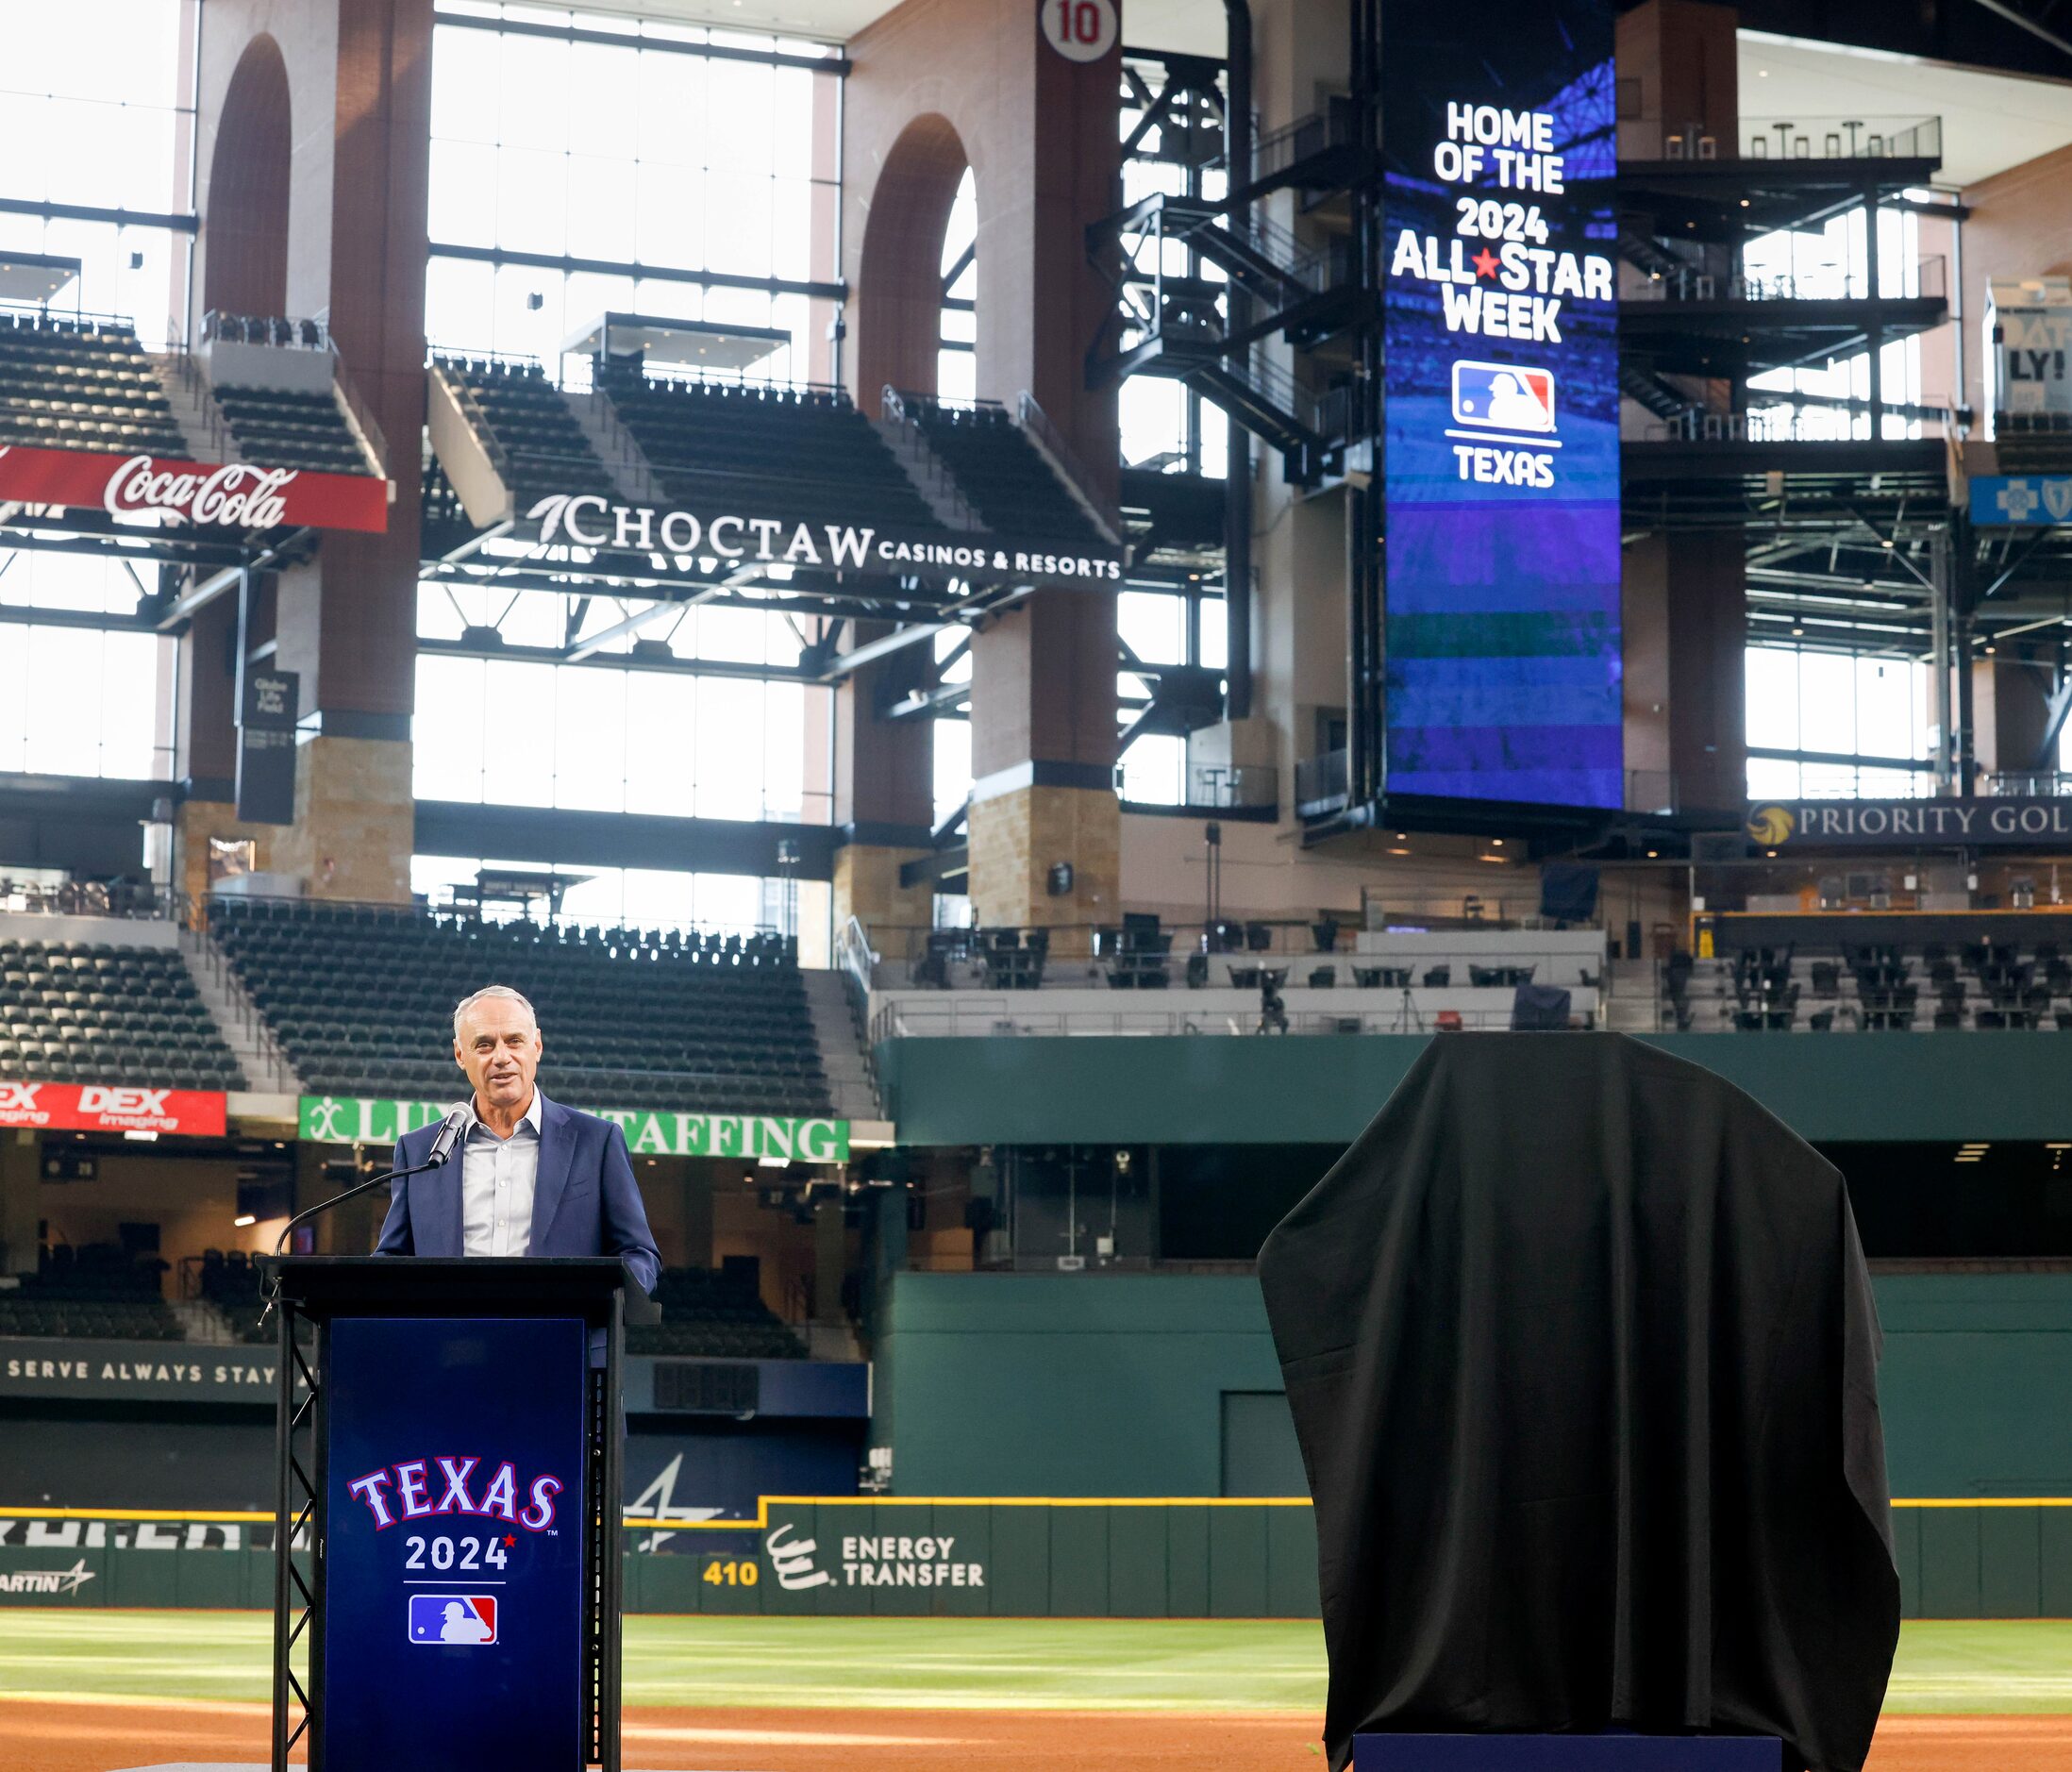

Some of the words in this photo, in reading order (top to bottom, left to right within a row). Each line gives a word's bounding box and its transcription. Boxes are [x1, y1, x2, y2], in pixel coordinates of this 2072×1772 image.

[1058, 0, 1100, 43] 10
[1447, 101, 1554, 153] HOME
[1434, 142, 1484, 183] OF
[1492, 148, 1565, 194] THE
[1456, 197, 1549, 244] 2024
[1391, 228, 1477, 285] ALL
[1500, 242, 1613, 301] STAR
[1441, 282, 1562, 343] WEEK
[2010, 350, 2064, 380] LY!
[1452, 444, 1555, 488] TEXAS
[564, 494, 875, 568] CHOCTAW
[878, 541, 985, 568] CASINOS
[993, 550, 1009, 570] &
[1015, 552, 1121, 579] RESORTS
[1800, 806, 1978, 835] PRIORITY
[1991, 805, 2069, 834] GOL
[77, 1085, 172, 1116] DEX
[98, 1112, 179, 1130] imaging
[576, 1108, 839, 1161] TAFFING
[8, 1360, 89, 1379] SERVE
[101, 1362, 202, 1382] ALWAYS
[214, 1364, 276, 1385] STAY
[346, 1456, 564, 1532] TEXAS
[405, 1535, 508, 1570] 2024
[842, 1535, 955, 1561] ENERGY
[703, 1561, 759, 1586] 410
[842, 1563, 985, 1587] TRANSFER
